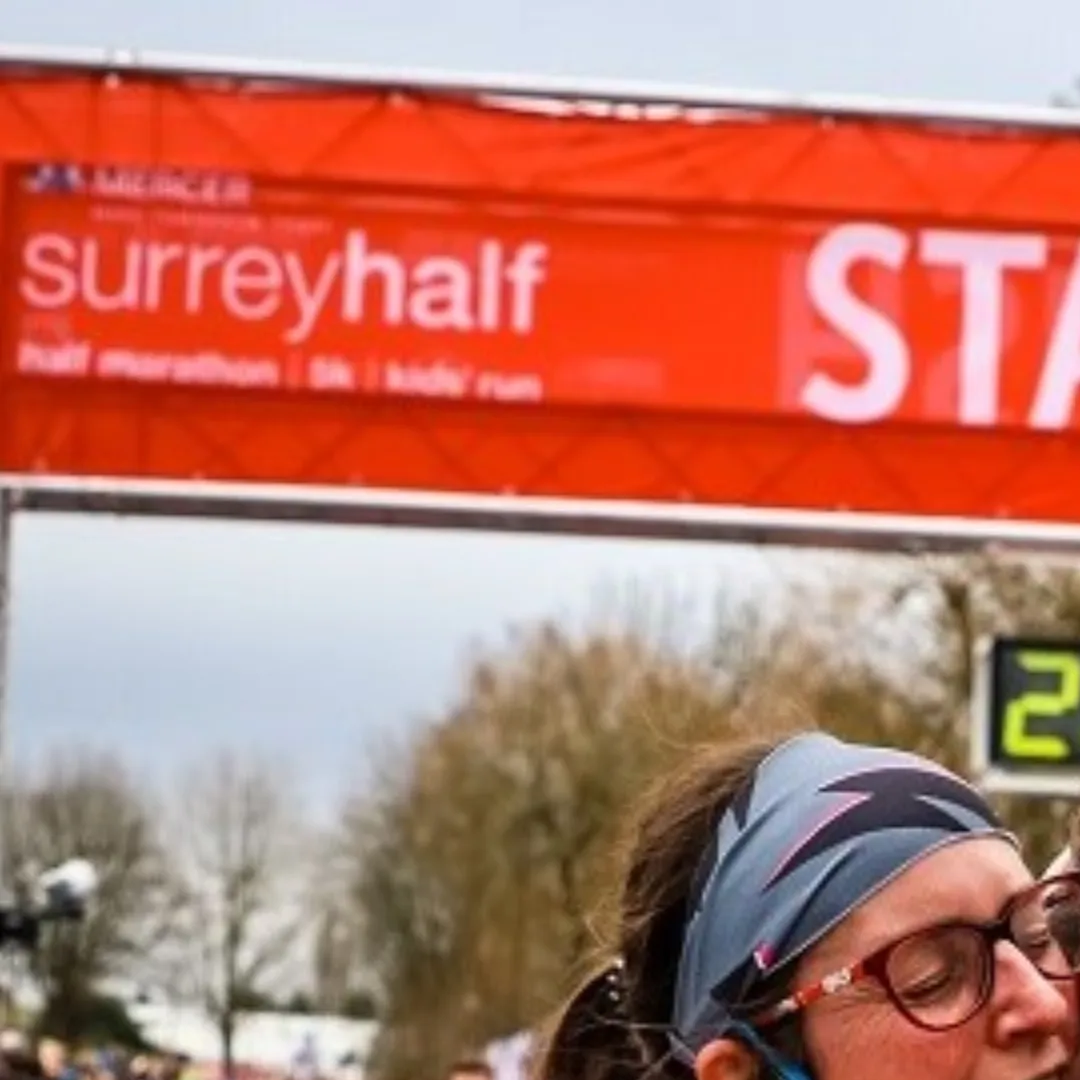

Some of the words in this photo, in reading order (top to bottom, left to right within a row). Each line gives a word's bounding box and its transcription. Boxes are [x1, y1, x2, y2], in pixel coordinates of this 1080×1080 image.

[18, 229, 549, 345] surreyhalf
[16, 339, 91, 378] half
[98, 347, 280, 388] marathon
[476, 370, 543, 403] run
